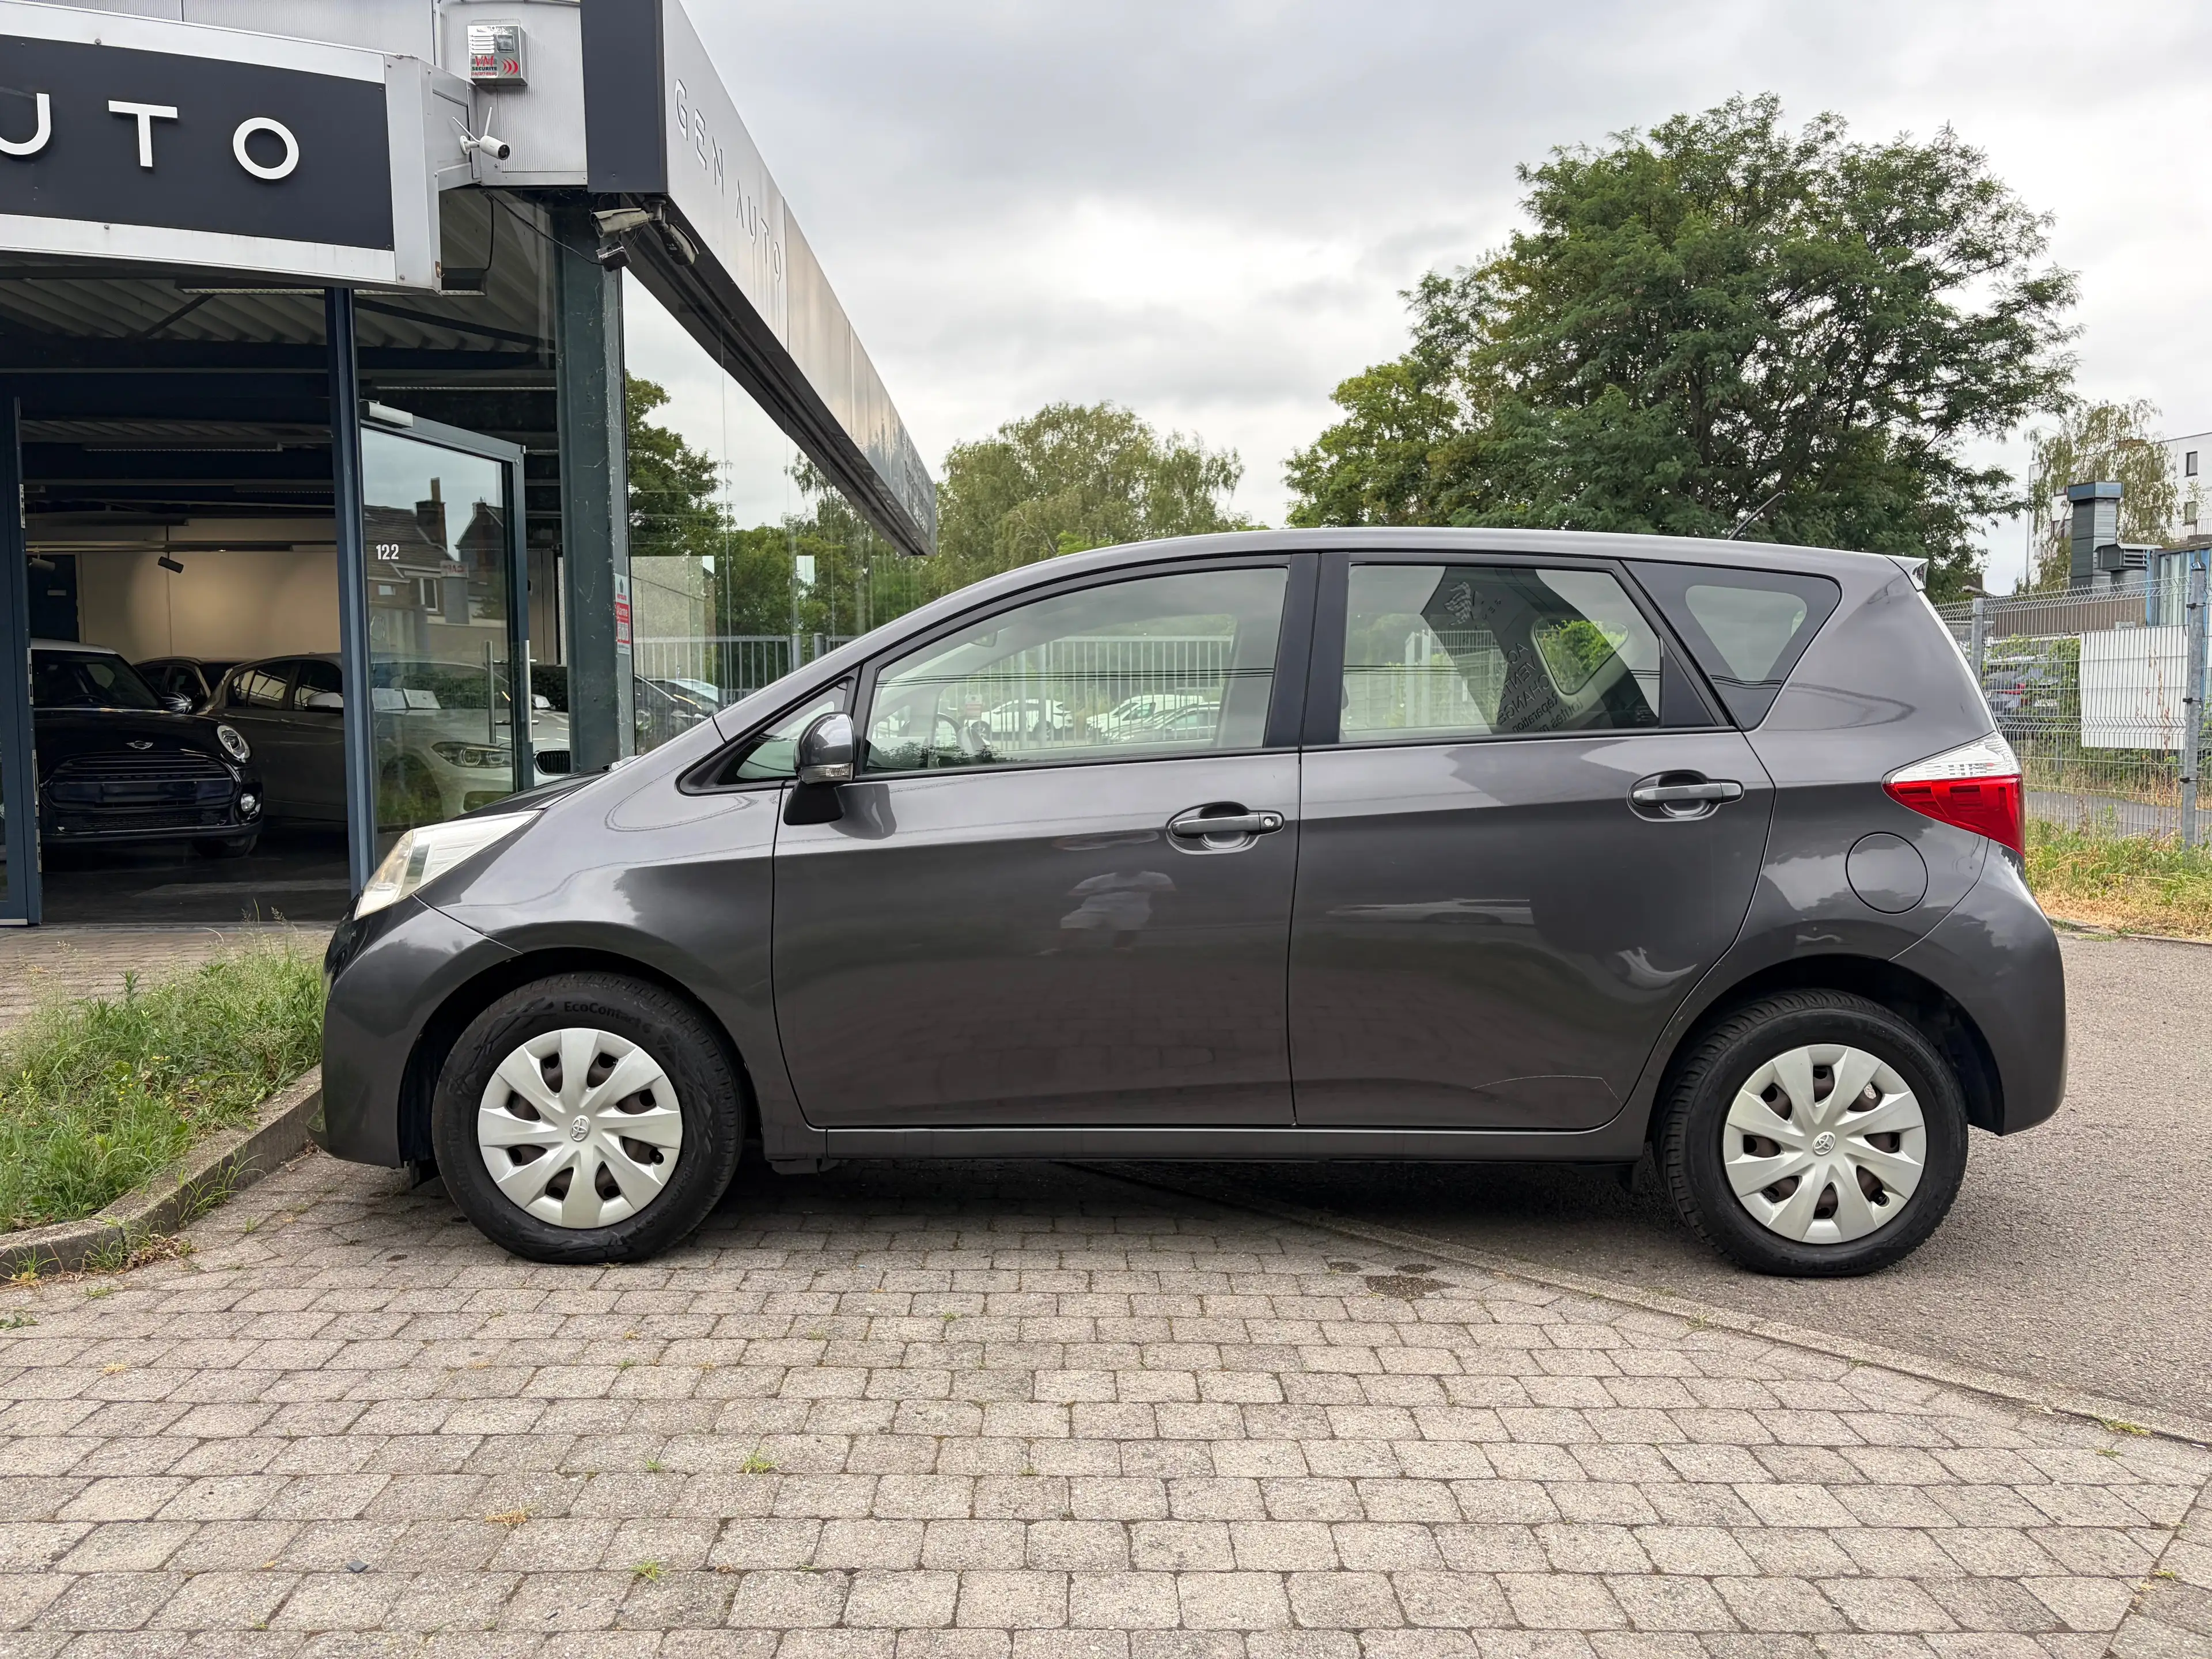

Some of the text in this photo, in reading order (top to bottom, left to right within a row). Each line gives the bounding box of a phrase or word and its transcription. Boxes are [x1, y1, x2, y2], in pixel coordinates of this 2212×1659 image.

[475, 55, 494, 67] VM
[675, 79, 781, 282] GEN AUTO
[376, 544, 399, 560] 122
[563, 1001, 641, 1028] EcoContact
